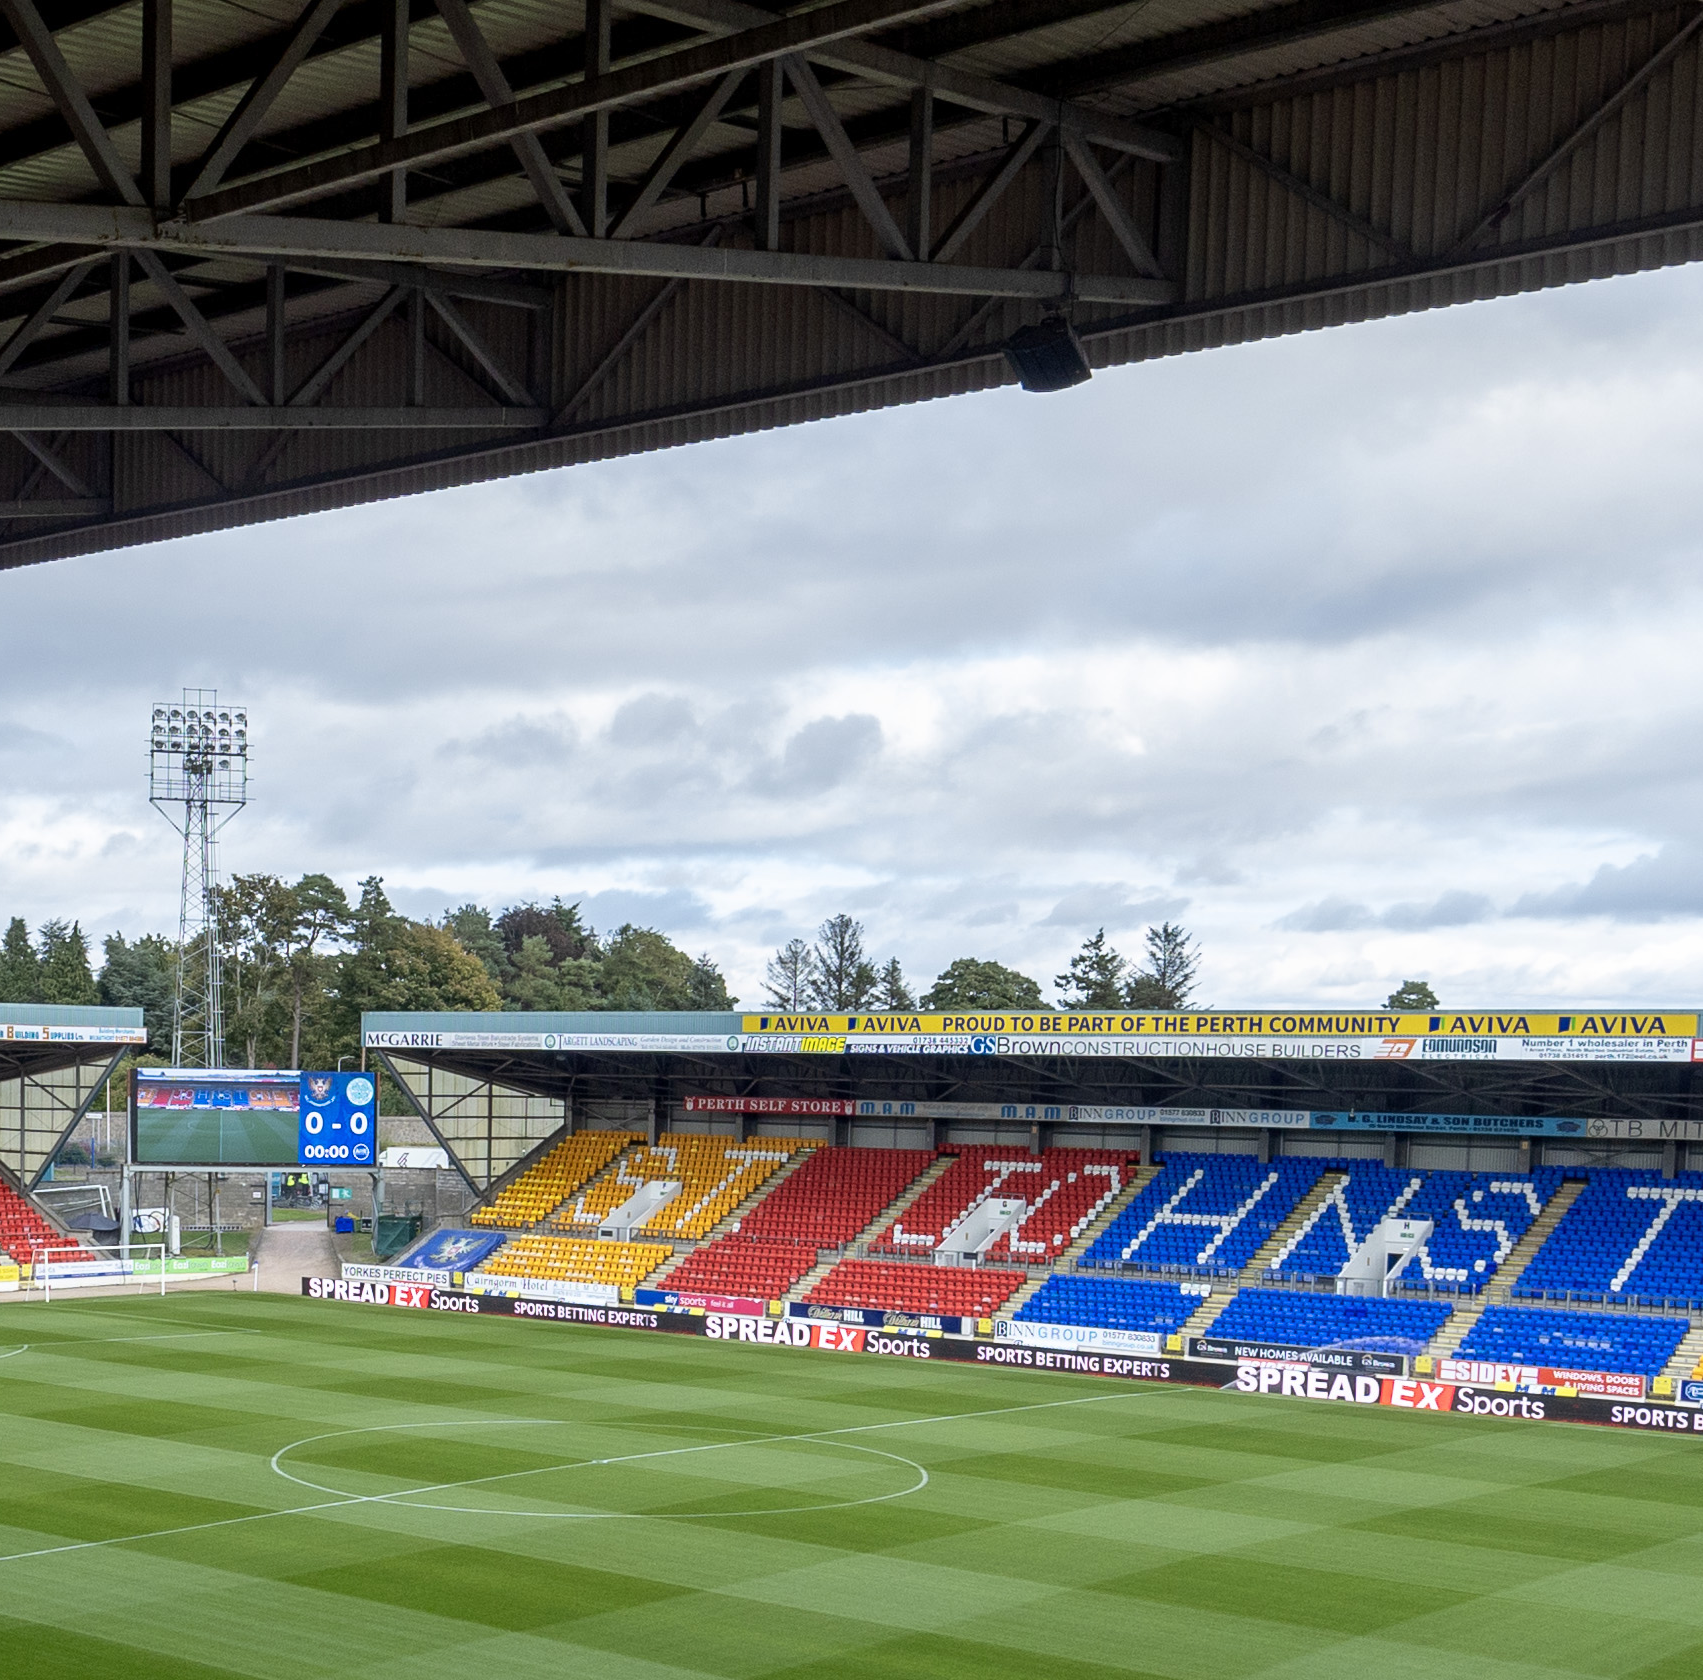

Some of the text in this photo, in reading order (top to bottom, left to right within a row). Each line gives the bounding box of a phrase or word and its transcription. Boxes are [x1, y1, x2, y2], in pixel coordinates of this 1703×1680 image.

[774, 1016, 1667, 1035] AVIVA AVIVA PROUD TO BE PART OF THE PERTH COMMUNITY AVIVA AVIVA
[1521, 1039, 1688, 1048] Number 1 wholesaler in Perth
[698, 1098, 841, 1113] PERTH SELF STORE
[305, 1111, 324, 1134] 0
[349, 1111, 368, 1134] 0
[1610, 1119, 1643, 1137] TB
[304, 1144, 349, 1158] 00:00
[343, 1266, 448, 1284] YORKES PERFECT PIES
[465, 1272, 518, 1291] Cairngorm
[520, 1277, 549, 1291] Hotel
[430, 1292, 480, 1313] Sports
[513, 1301, 658, 1328] SPORTS BETTING EXPERTS
[866, 1331, 931, 1358] Sports
[977, 1346, 1170, 1378] SPORTS BETTING EXPERTS
[1235, 1345, 1354, 1367] NEW HOMES AVAILABLE
[1455, 1361, 1522, 1384] SIDEY
[1456, 1387, 1546, 1420] Sports
[1610, 1405, 1689, 1429] SPORTS
